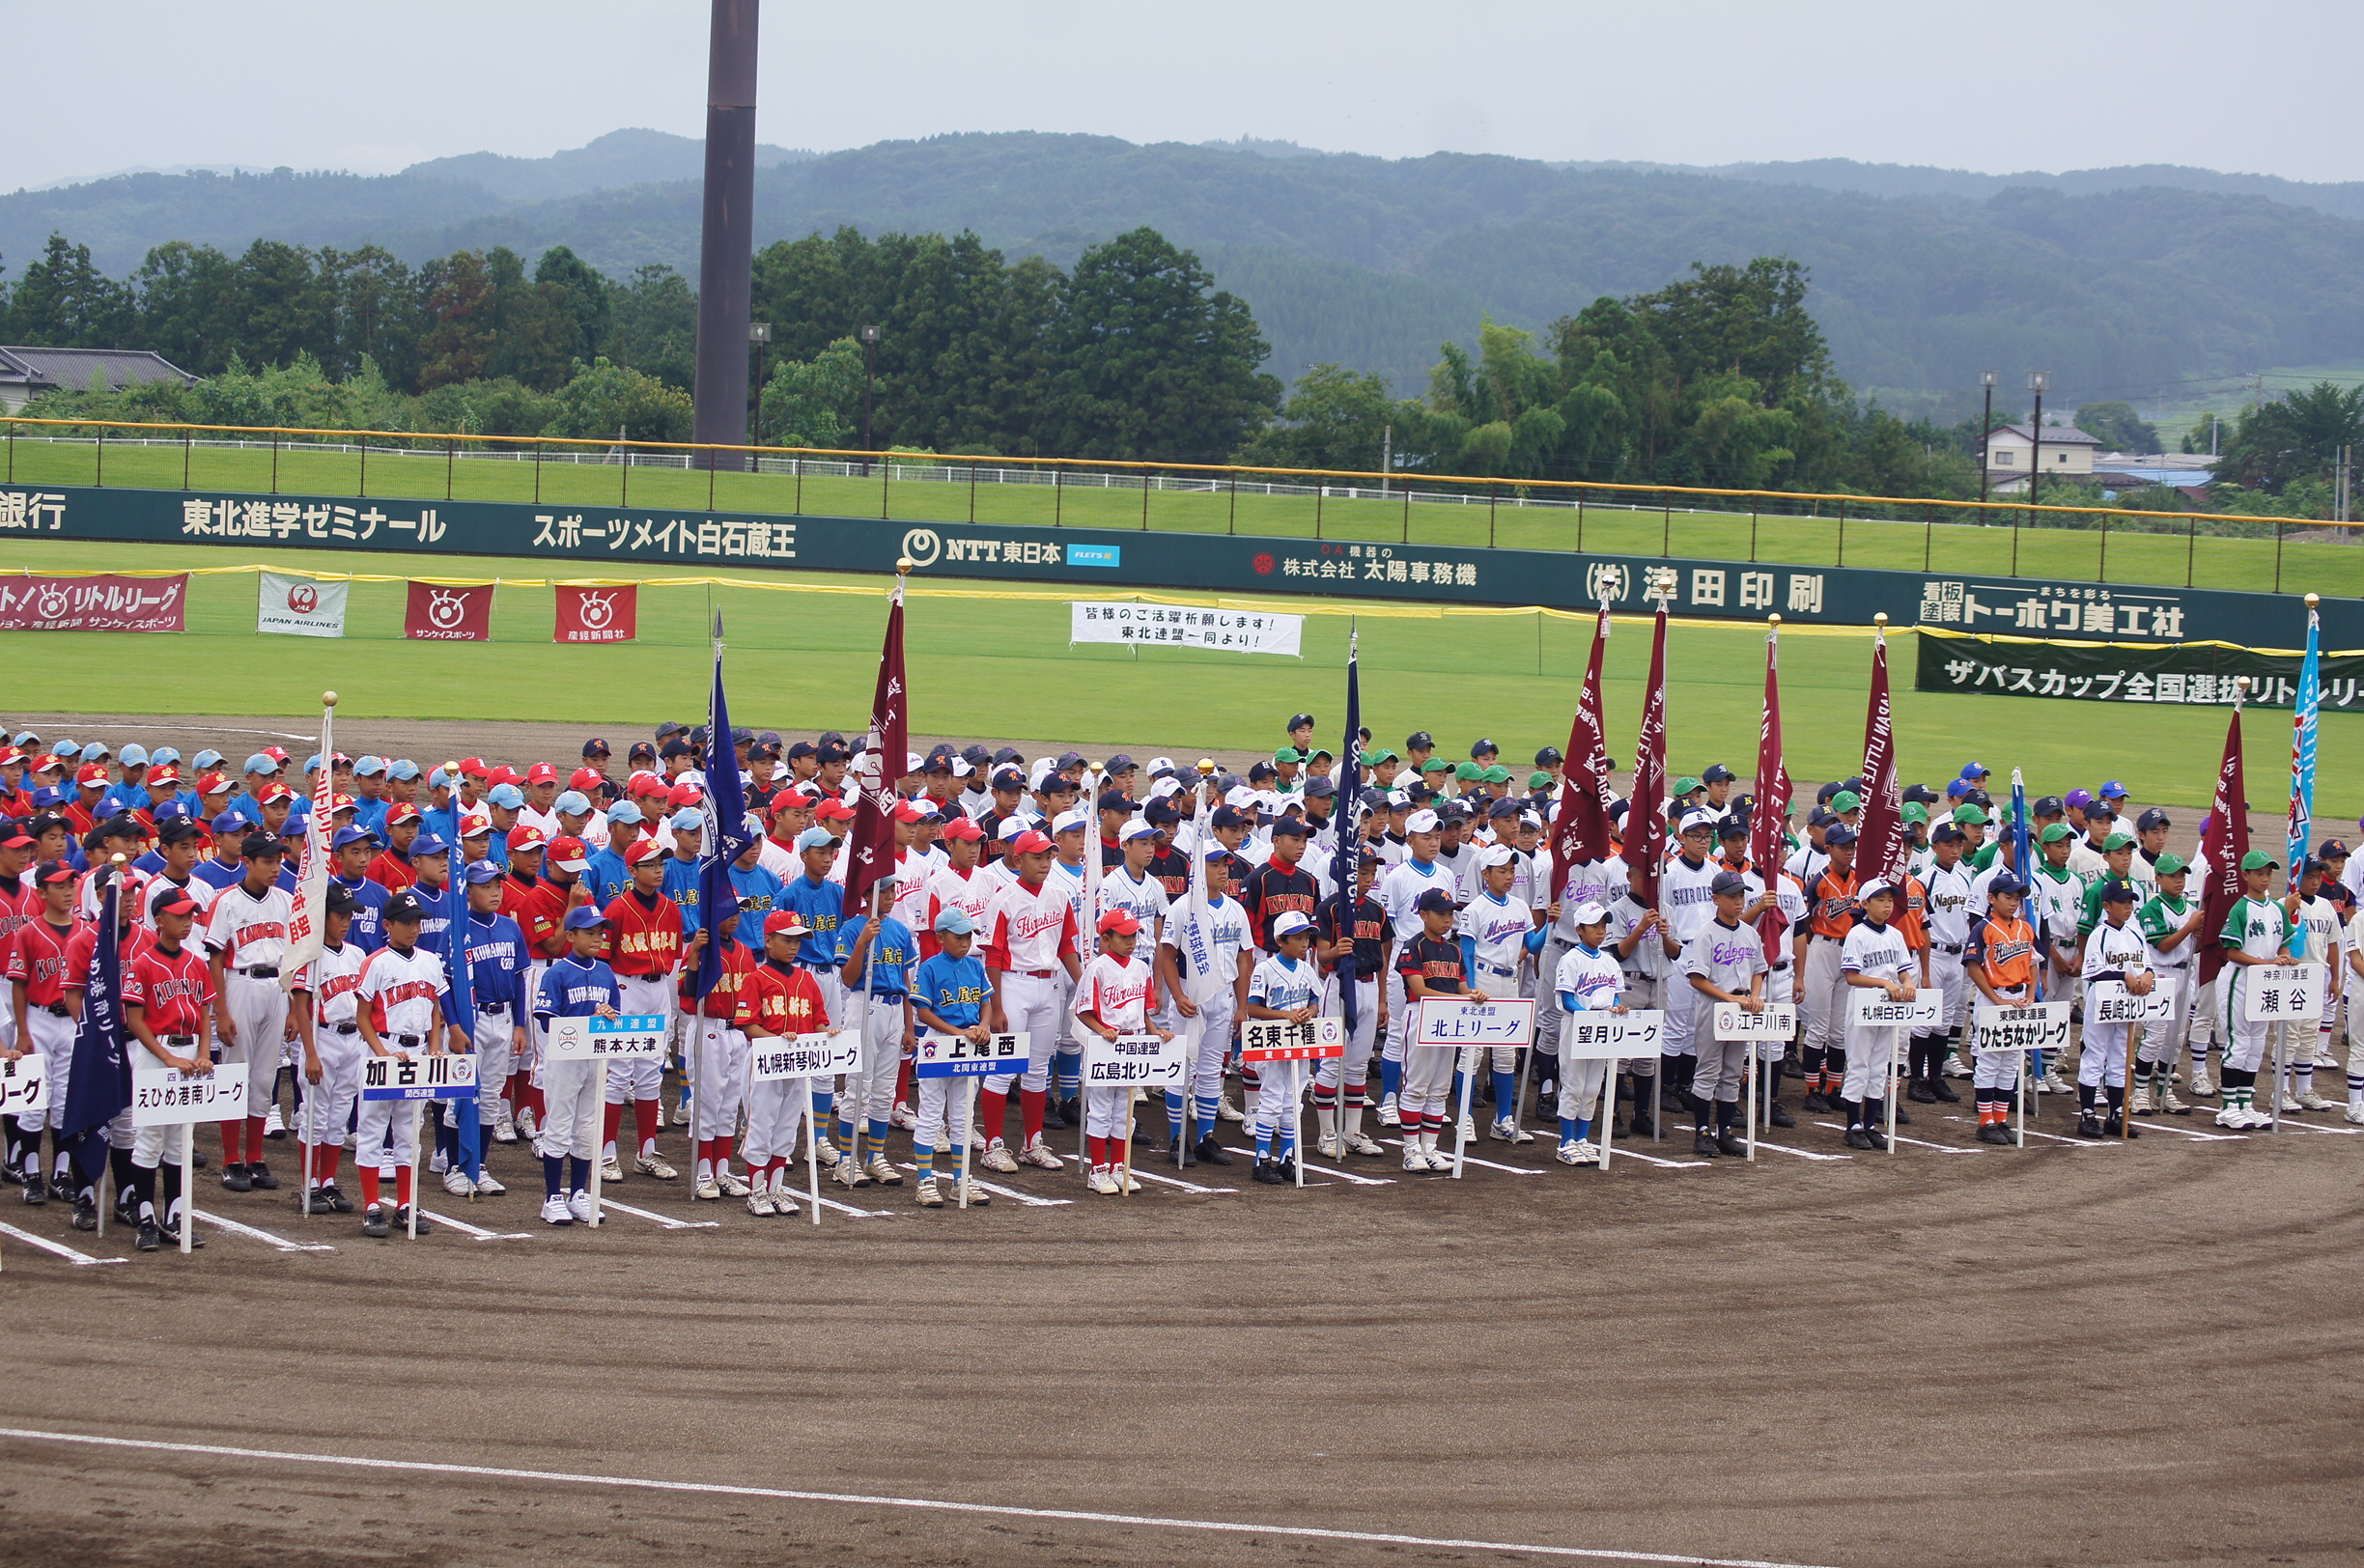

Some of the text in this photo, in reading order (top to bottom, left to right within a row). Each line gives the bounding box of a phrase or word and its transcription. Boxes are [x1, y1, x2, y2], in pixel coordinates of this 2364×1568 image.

[0, 491, 66, 531] 銀行
[182, 498, 447, 543] 東北進学ゼミナール
[533, 514, 797, 558] スポーツメイト白石蔵王
[1283, 557, 1478, 586] 株式会社 太陽事務機
[74, 583, 181, 614] リトルリーグ
[1924, 581, 1963, 602] 看板
[2040, 586, 2112, 601] まちを彩る
[1085, 606, 1275, 631] 皆様のご活躍祈願します!
[1920, 601, 1961, 622] 塗装
[1964, 594, 2184, 637] トーホク美工社
[89, 616, 177, 630] サンケイスポーツ
[294, 619, 339, 629] AIRLINES
[416, 629, 475, 641] サンケイスポーツ
[1121, 626, 1261, 648] 東北連盟一同より!
[1944, 659, 2364, 707] ザバスカップ全国選抜リトリ
[674, 888, 699, 907] 上尾
[1933, 891, 1967, 912] Nagasa
[472, 940, 516, 963] KUMAMOTO
[2263, 968, 2308, 981] 神奈川連盟
[940, 986, 981, 1007] 上尾西
[2260, 988, 2307, 1013] 瀬谷
[1459, 1006, 1496, 1017] 東北連盟
[1862, 1005, 1936, 1022] 札幌白石リーグ
[1999, 1008, 2047, 1022] 東関東連盟
[2099, 995, 2171, 1022] 長崎北リーグ
[597, 1018, 657, 1031] 九州連盟
[1431, 1020, 1521, 1039] 北上リーグ
[1737, 1013, 1791, 1032] 江戸川南
[593, 1038, 657, 1053] 熊本大津
[787, 1041, 829, 1050] 北海道連盟
[1248, 1022, 1316, 1049] 名東千種
[1577, 1024, 1658, 1046] 望月リーグ
[1980, 1021, 2068, 1049] ひたちなかリーグ
[949, 1035, 1016, 1059] 上尾西
[1114, 1042, 1160, 1056] 中国連盟
[366, 1058, 447, 1086] 加古川
[757, 1047, 858, 1076] 札幌新琴似リーグ
[952, 1062, 997, 1073] 北関東連盟
[1090, 1062, 1182, 1081] 広島北リーグ
[139, 1080, 244, 1108] えひめ港南リーグ
